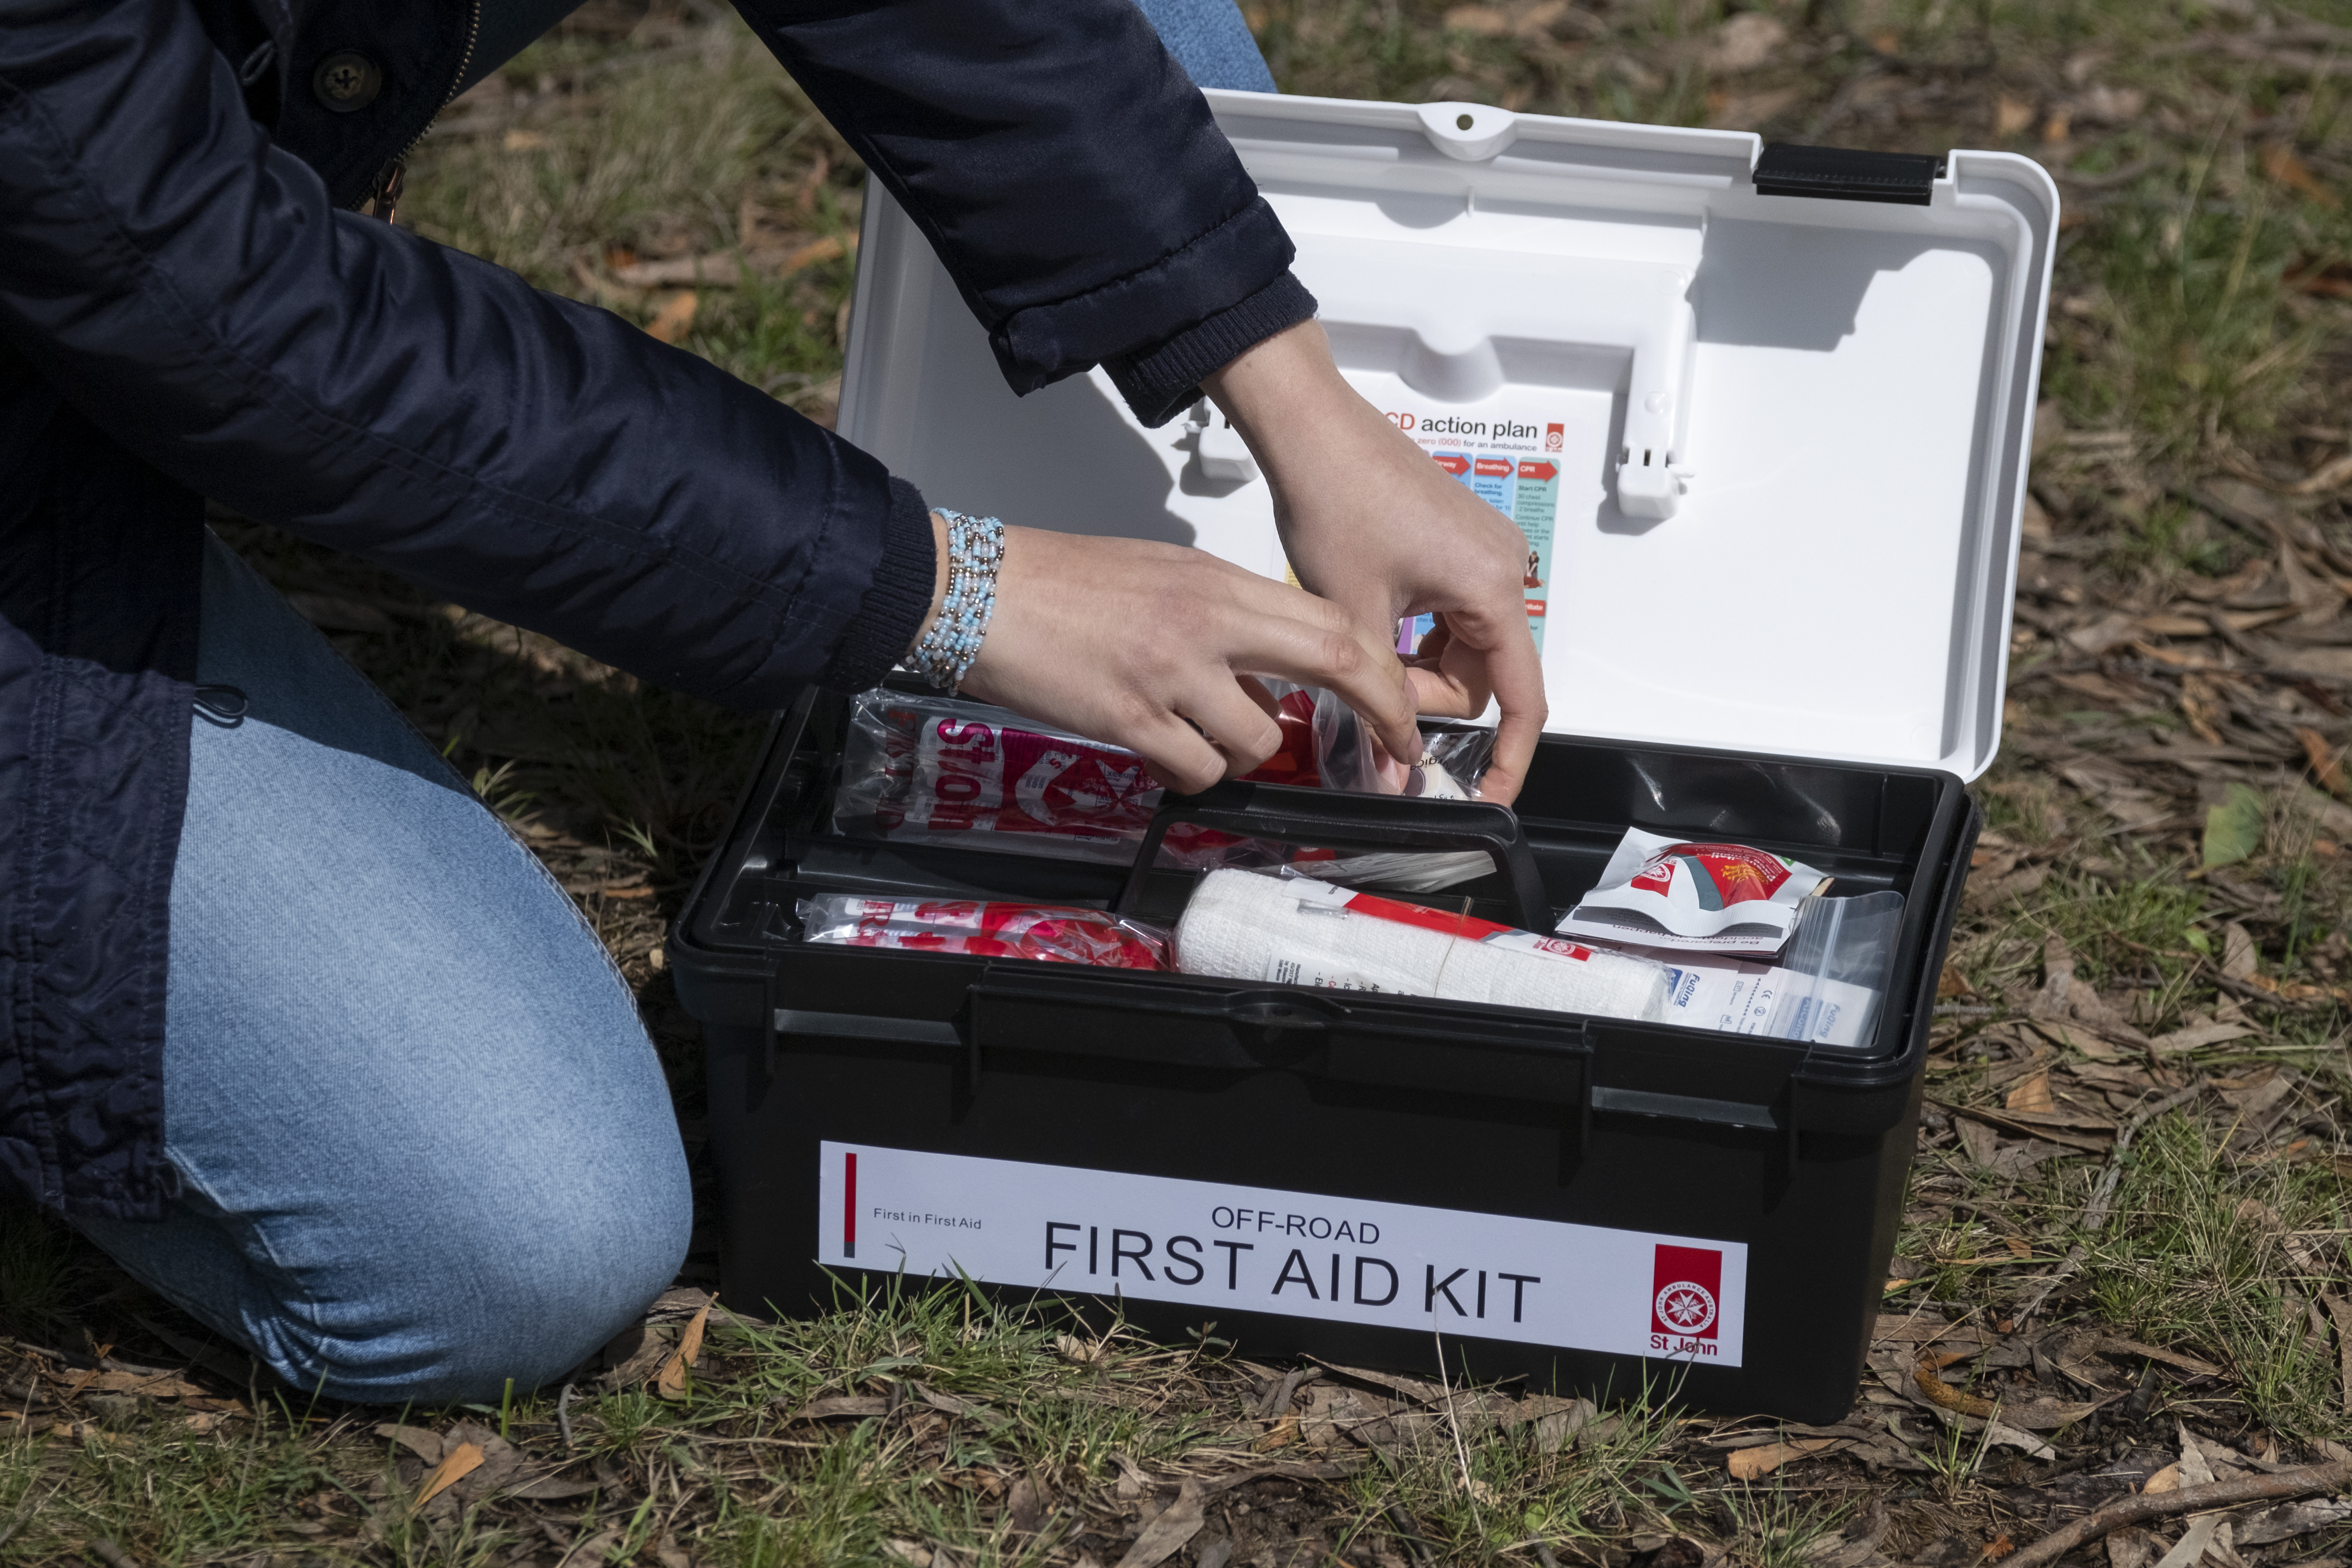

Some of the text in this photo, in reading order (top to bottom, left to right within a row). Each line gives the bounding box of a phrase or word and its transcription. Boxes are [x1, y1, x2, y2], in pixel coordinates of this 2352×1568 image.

[1422, 417, 1486, 435] action
[1493, 420, 1538, 440] plan
[1439, 437, 1461, 446] (000)
[1491, 442, 1537, 451] ambulance
[1476, 463, 1509, 473] Breathing
[936, 718, 995, 764] St
[1612, 924, 1665, 936] happen
[1678, 973, 1700, 1008] FuQing
[874, 1208, 981, 1229] First in First Aid
[1212, 1206, 1379, 1244] OFF-ROAD
[1045, 1221, 1541, 1323] FIRST AID KIT
[1664, 1283, 1706, 1295] AMBULANCE
[1699, 1295, 1713, 1328] AUSTRALIA
[1650, 1334, 1718, 1356] St John
